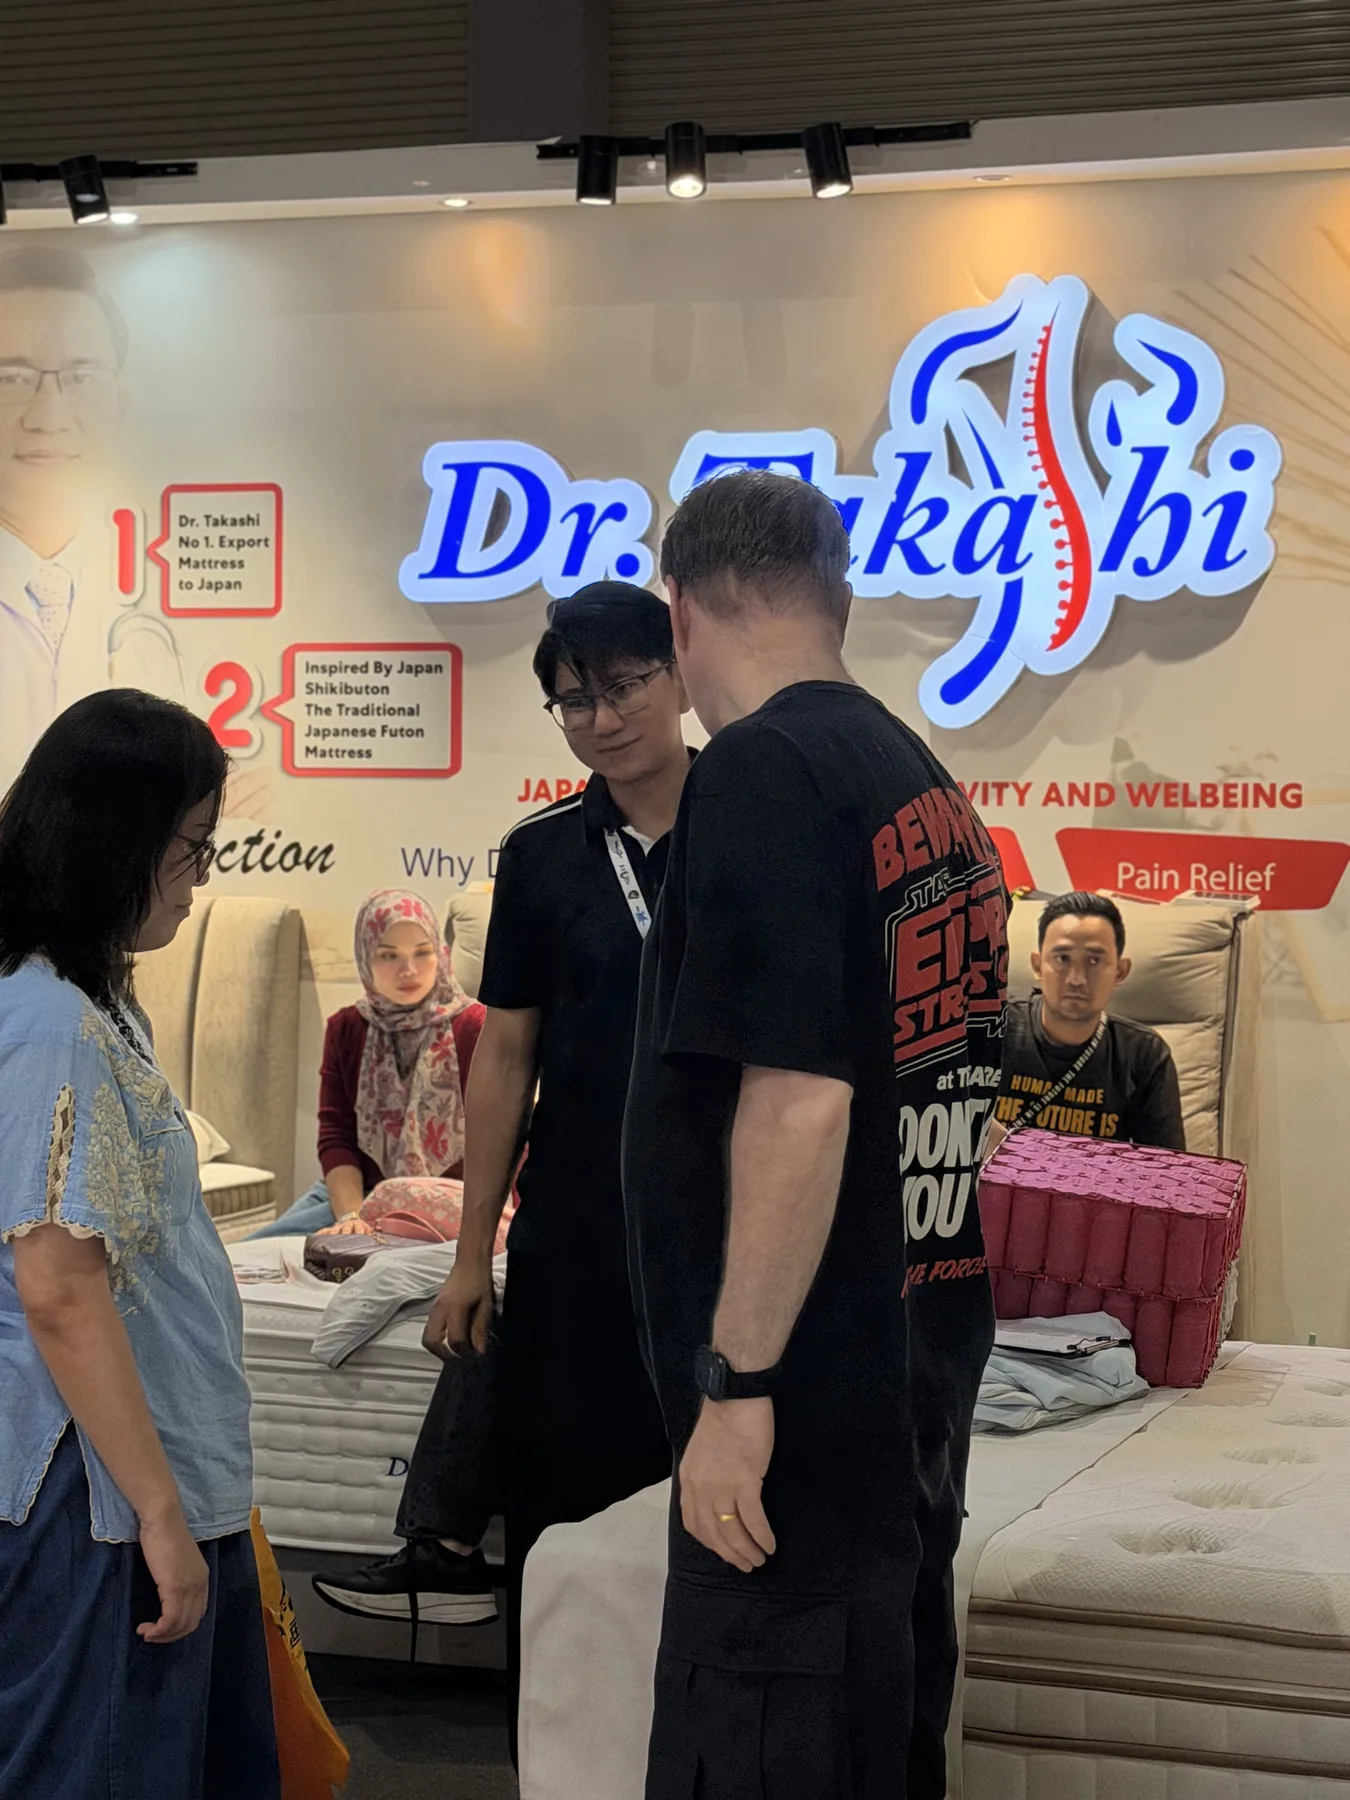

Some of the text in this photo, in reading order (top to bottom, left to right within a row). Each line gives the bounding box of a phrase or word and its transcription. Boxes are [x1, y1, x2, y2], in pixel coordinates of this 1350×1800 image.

[178, 513, 260, 527] Dr. Takashi
[418, 461, 641, 579] Dr.
[113, 508, 135, 595] 1
[178, 535, 270, 551] No 1. Export
[178, 557, 245, 570] Mattress
[178, 578, 242, 592] to Japan
[305, 660, 444, 678] Inspired By Japan
[305, 682, 390, 696] Shikibuton
[204, 661, 253, 748] 2
[305, 703, 420, 717] The Traditional
[305, 724, 425, 740] Japanese Futon
[305, 746, 373, 759] Mattress
[956, 781, 1033, 807] VITY
[1041, 781, 1116, 808] AND
[1124, 781, 1303, 809] WELBEING
[215, 827, 335, 875] ction
[401, 847, 474, 887] Why
[1117, 862, 1277, 892] Pain Relief
[936, 1070, 954, 1091] at
[1010, 1074, 1105, 1105] HUMA MADE
[996, 1095, 1119, 1137] HE UTURE IS
